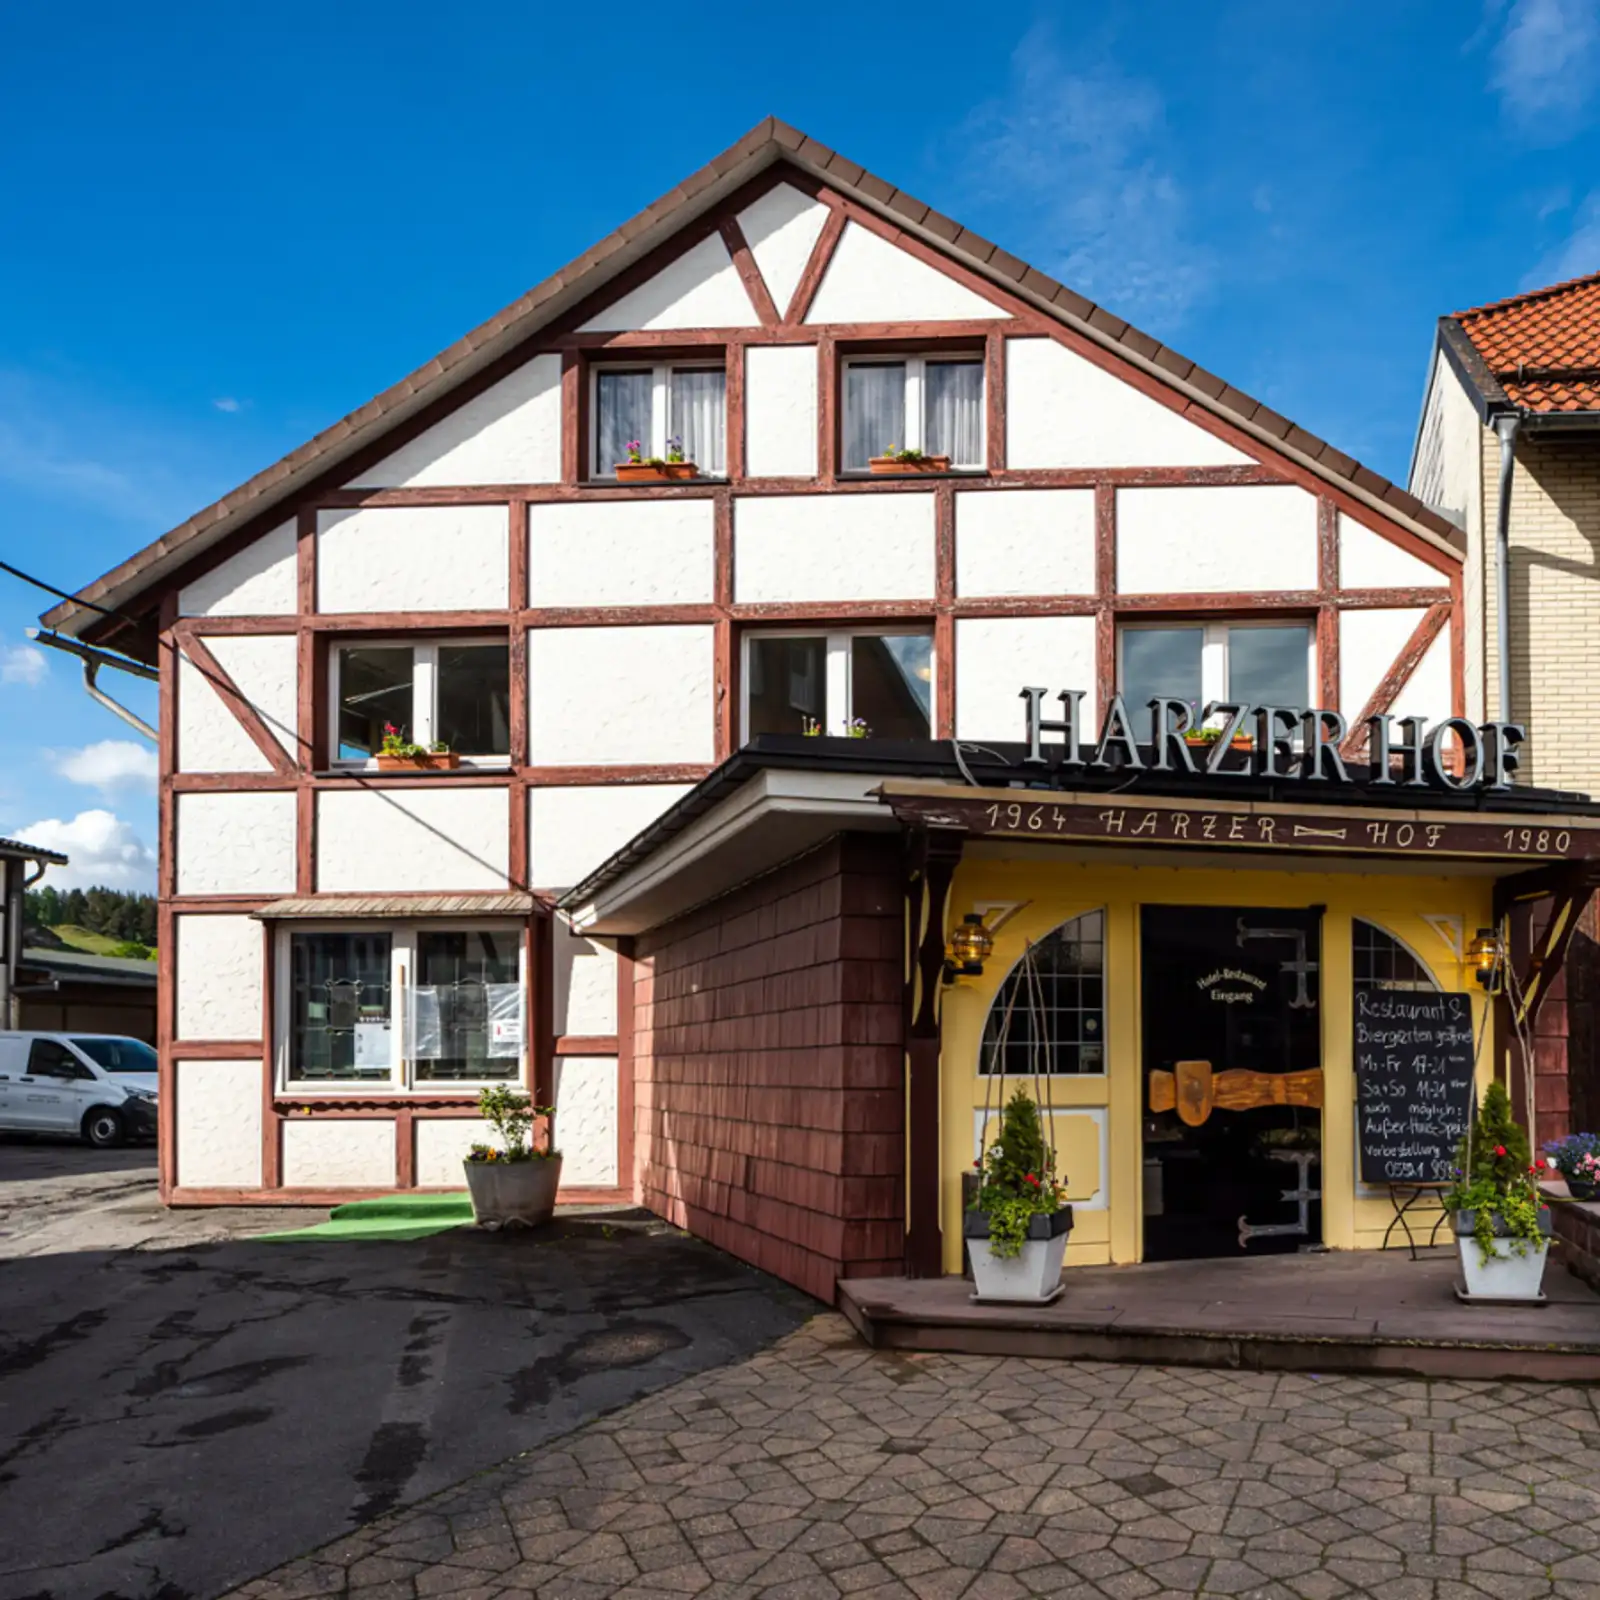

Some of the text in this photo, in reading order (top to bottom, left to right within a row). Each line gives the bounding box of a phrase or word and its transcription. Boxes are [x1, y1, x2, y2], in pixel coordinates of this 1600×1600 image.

[1019, 686, 1526, 792] HARZER HOF
[986, 803, 1571, 853] 1964 HARZER HOF 1980
[1211, 989, 1253, 1004] Eingang
[1356, 992, 1445, 1021] Restaurant
[1356, 1021, 1432, 1048] Biergarten
